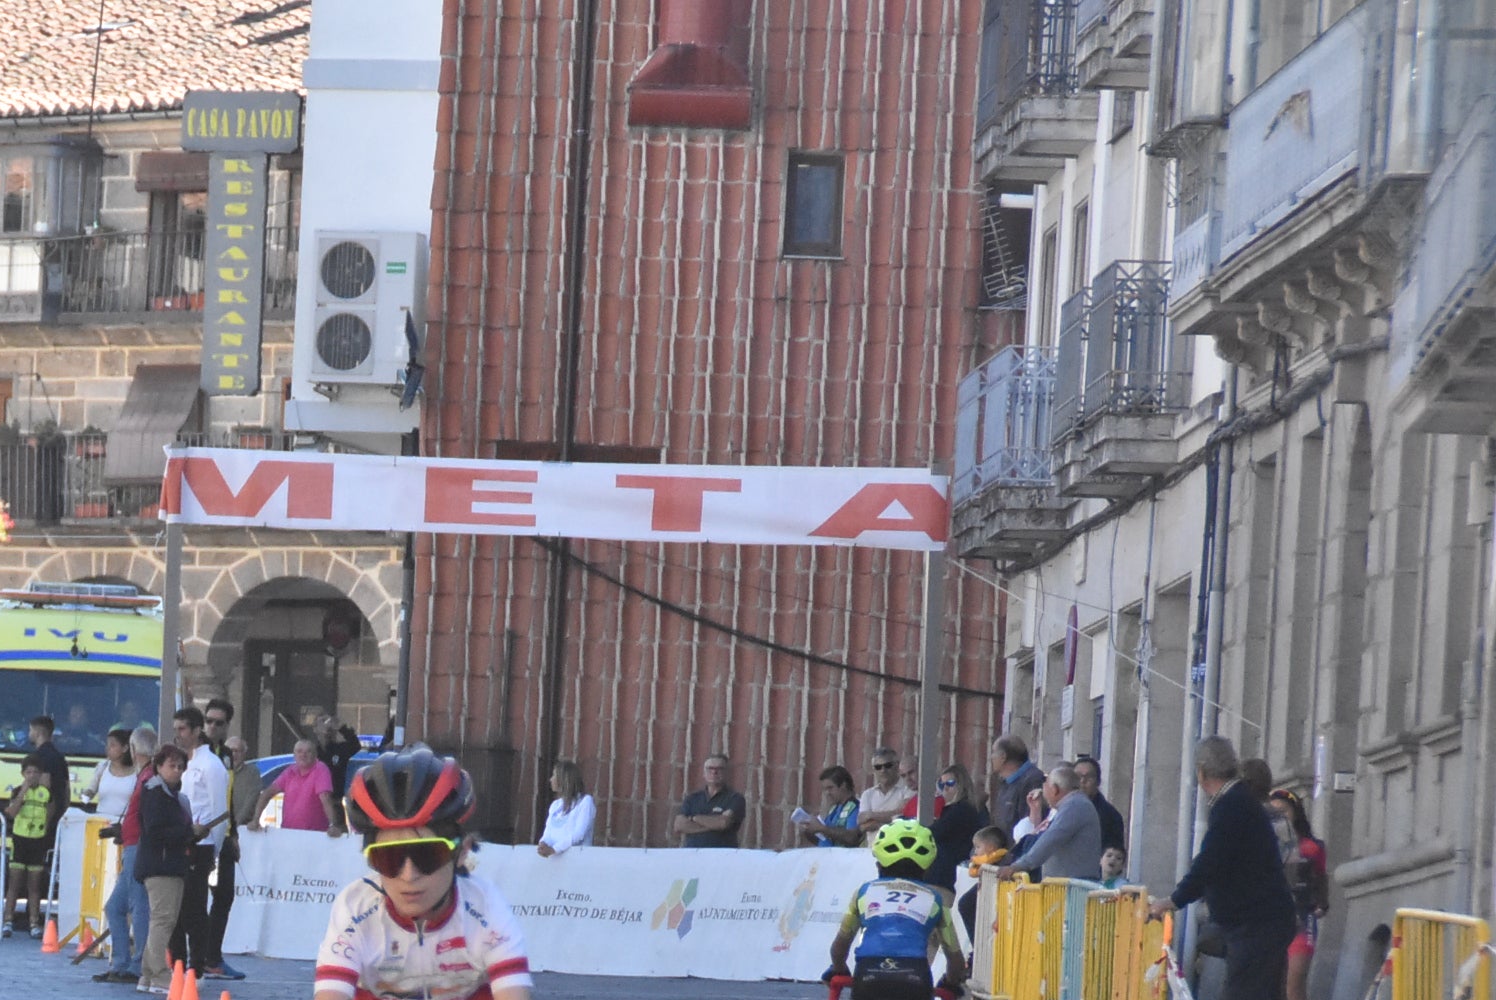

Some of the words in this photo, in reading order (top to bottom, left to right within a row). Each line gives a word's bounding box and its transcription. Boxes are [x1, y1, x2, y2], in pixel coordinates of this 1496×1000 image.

[187, 106, 230, 138] CASA
[235, 101, 295, 139] PAVÓN
[211, 158, 254, 390] RESTAURANTE
[159, 456, 950, 543] META
[292, 874, 339, 888] Excmo.
[886, 890, 918, 904] 27
[590, 907, 609, 920] DE
[609, 905, 644, 924] BÉJAR
